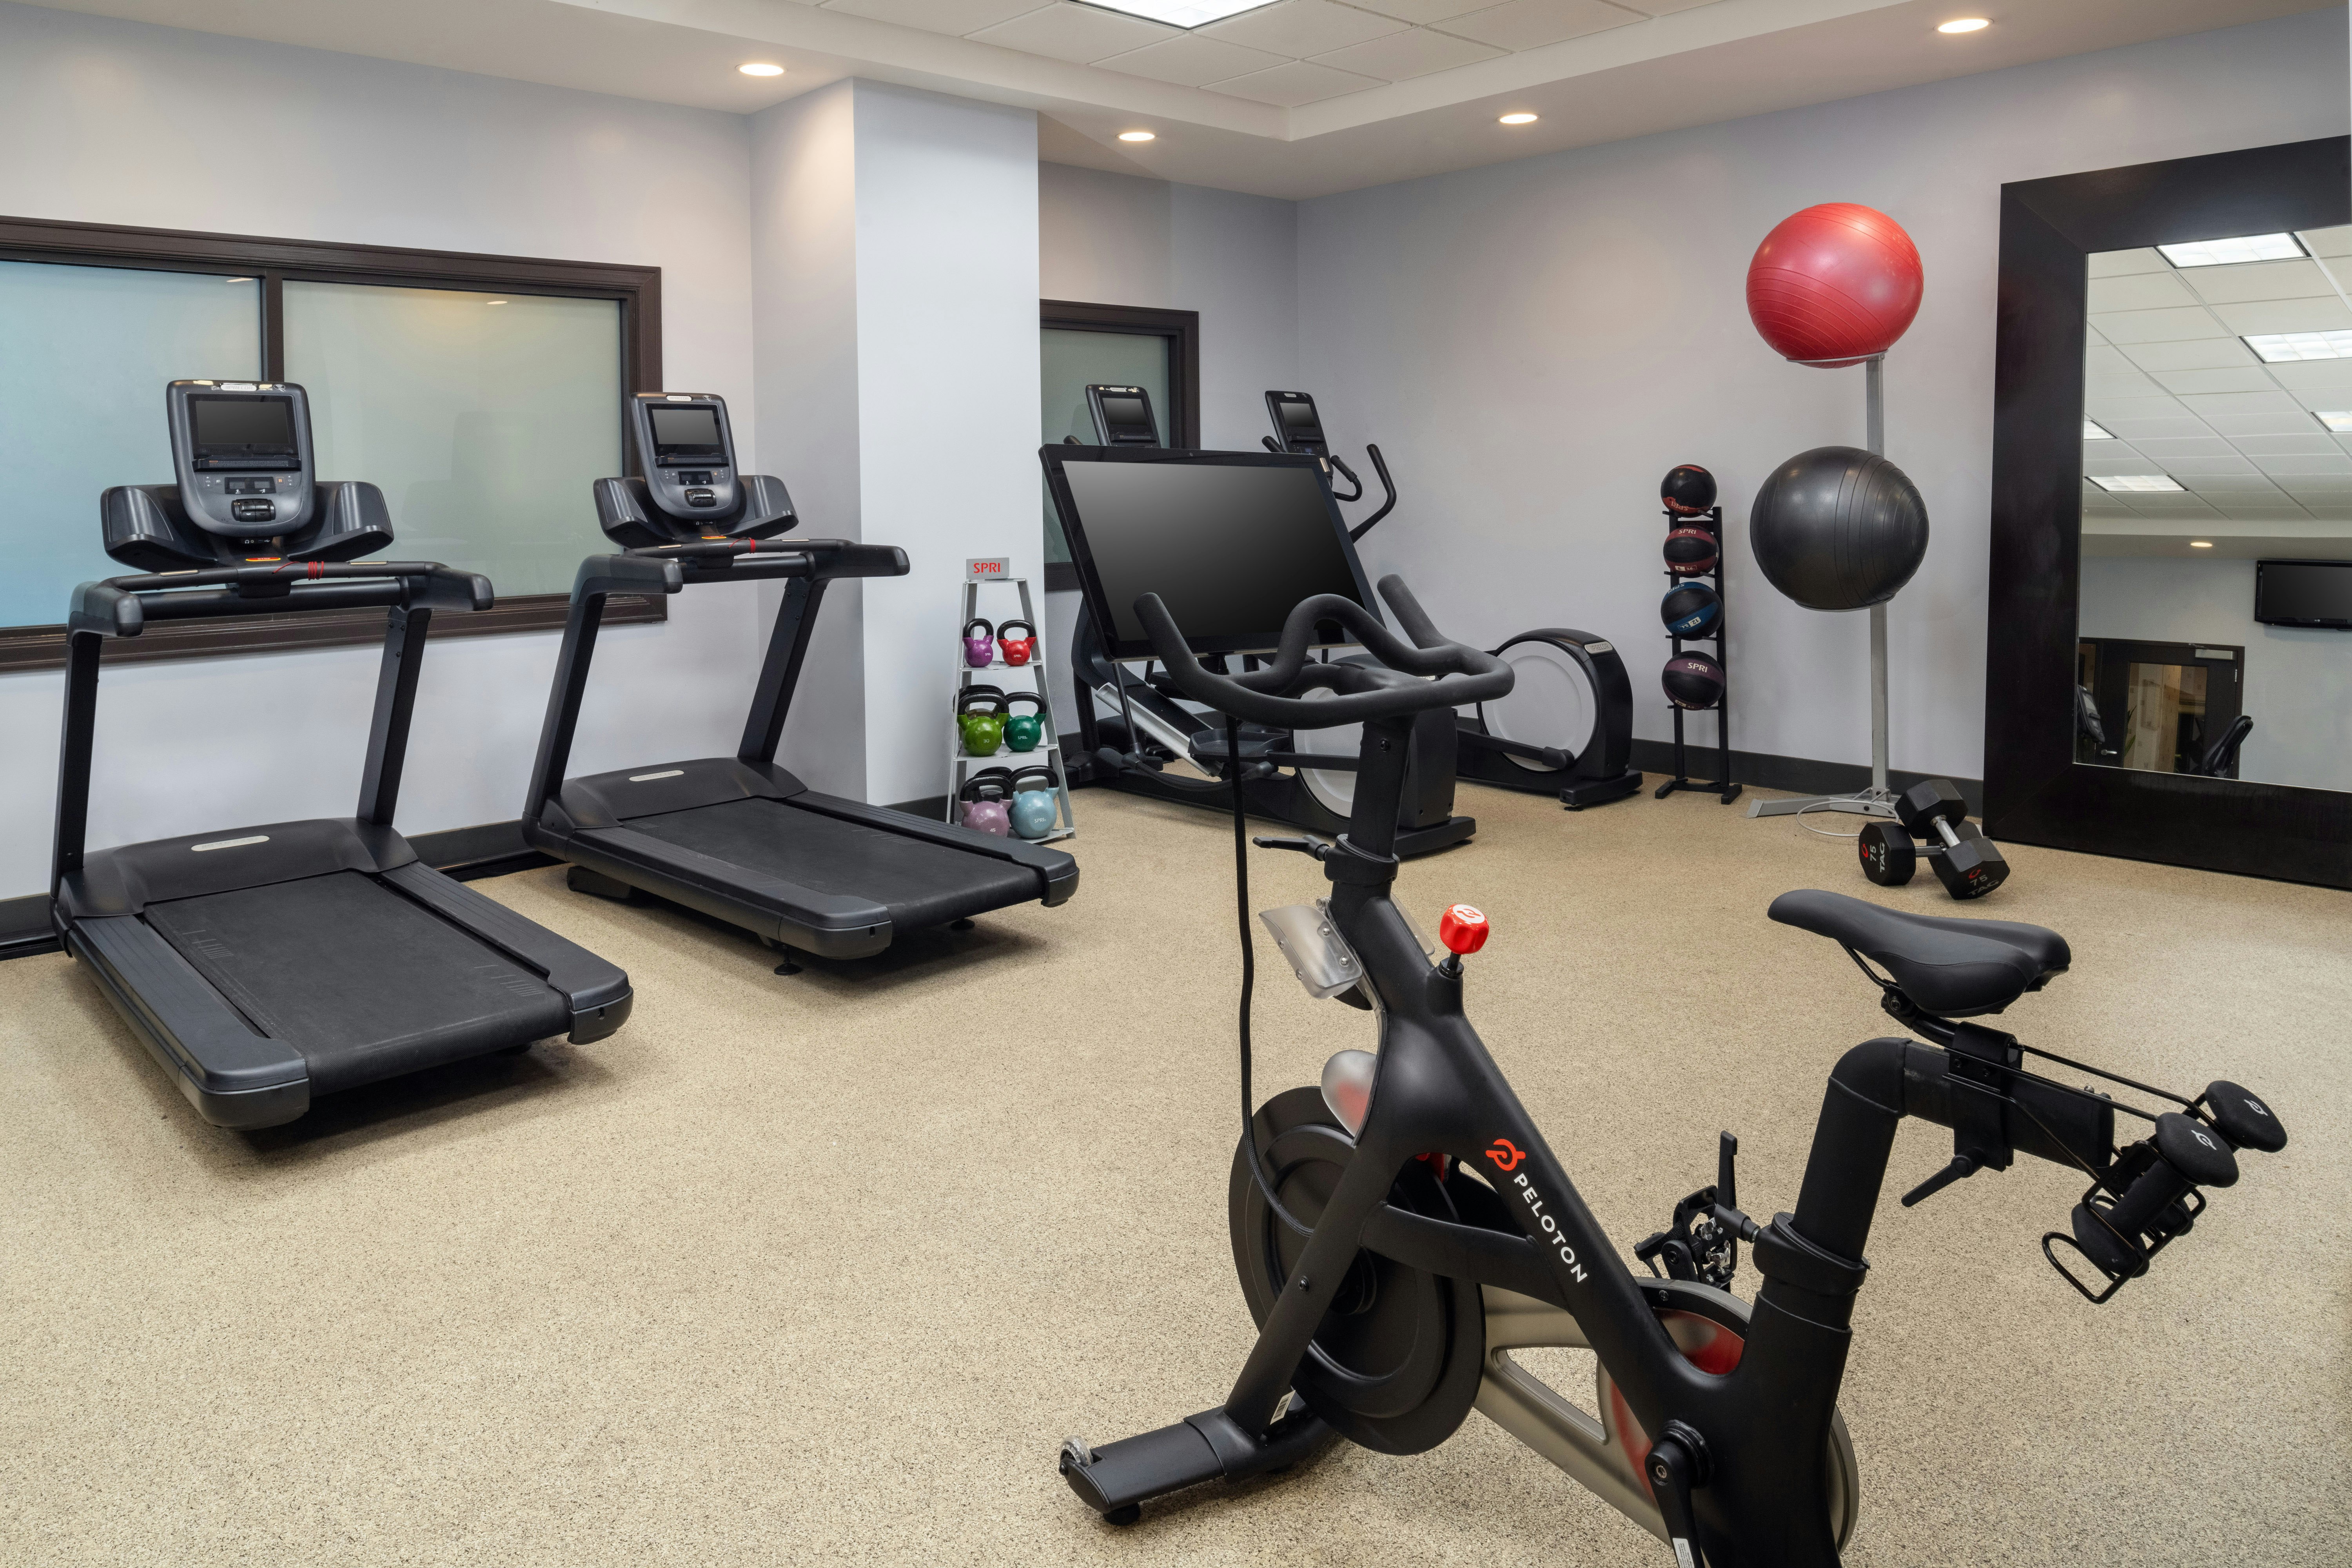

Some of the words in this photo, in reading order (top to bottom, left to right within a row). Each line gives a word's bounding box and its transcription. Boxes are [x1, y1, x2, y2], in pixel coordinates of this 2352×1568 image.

[1671, 501, 1688, 511] SPRI
[973, 563, 1000, 573] SPRI
[1668, 583, 1685, 594] SPRI
[1688, 662, 1708, 673] SPRI
[1870, 845, 1877, 861] 75
[1970, 875, 1988, 886] 75
[1968, 879, 1999, 895] TAG
[1514, 1173, 1588, 1283] PELOTON
